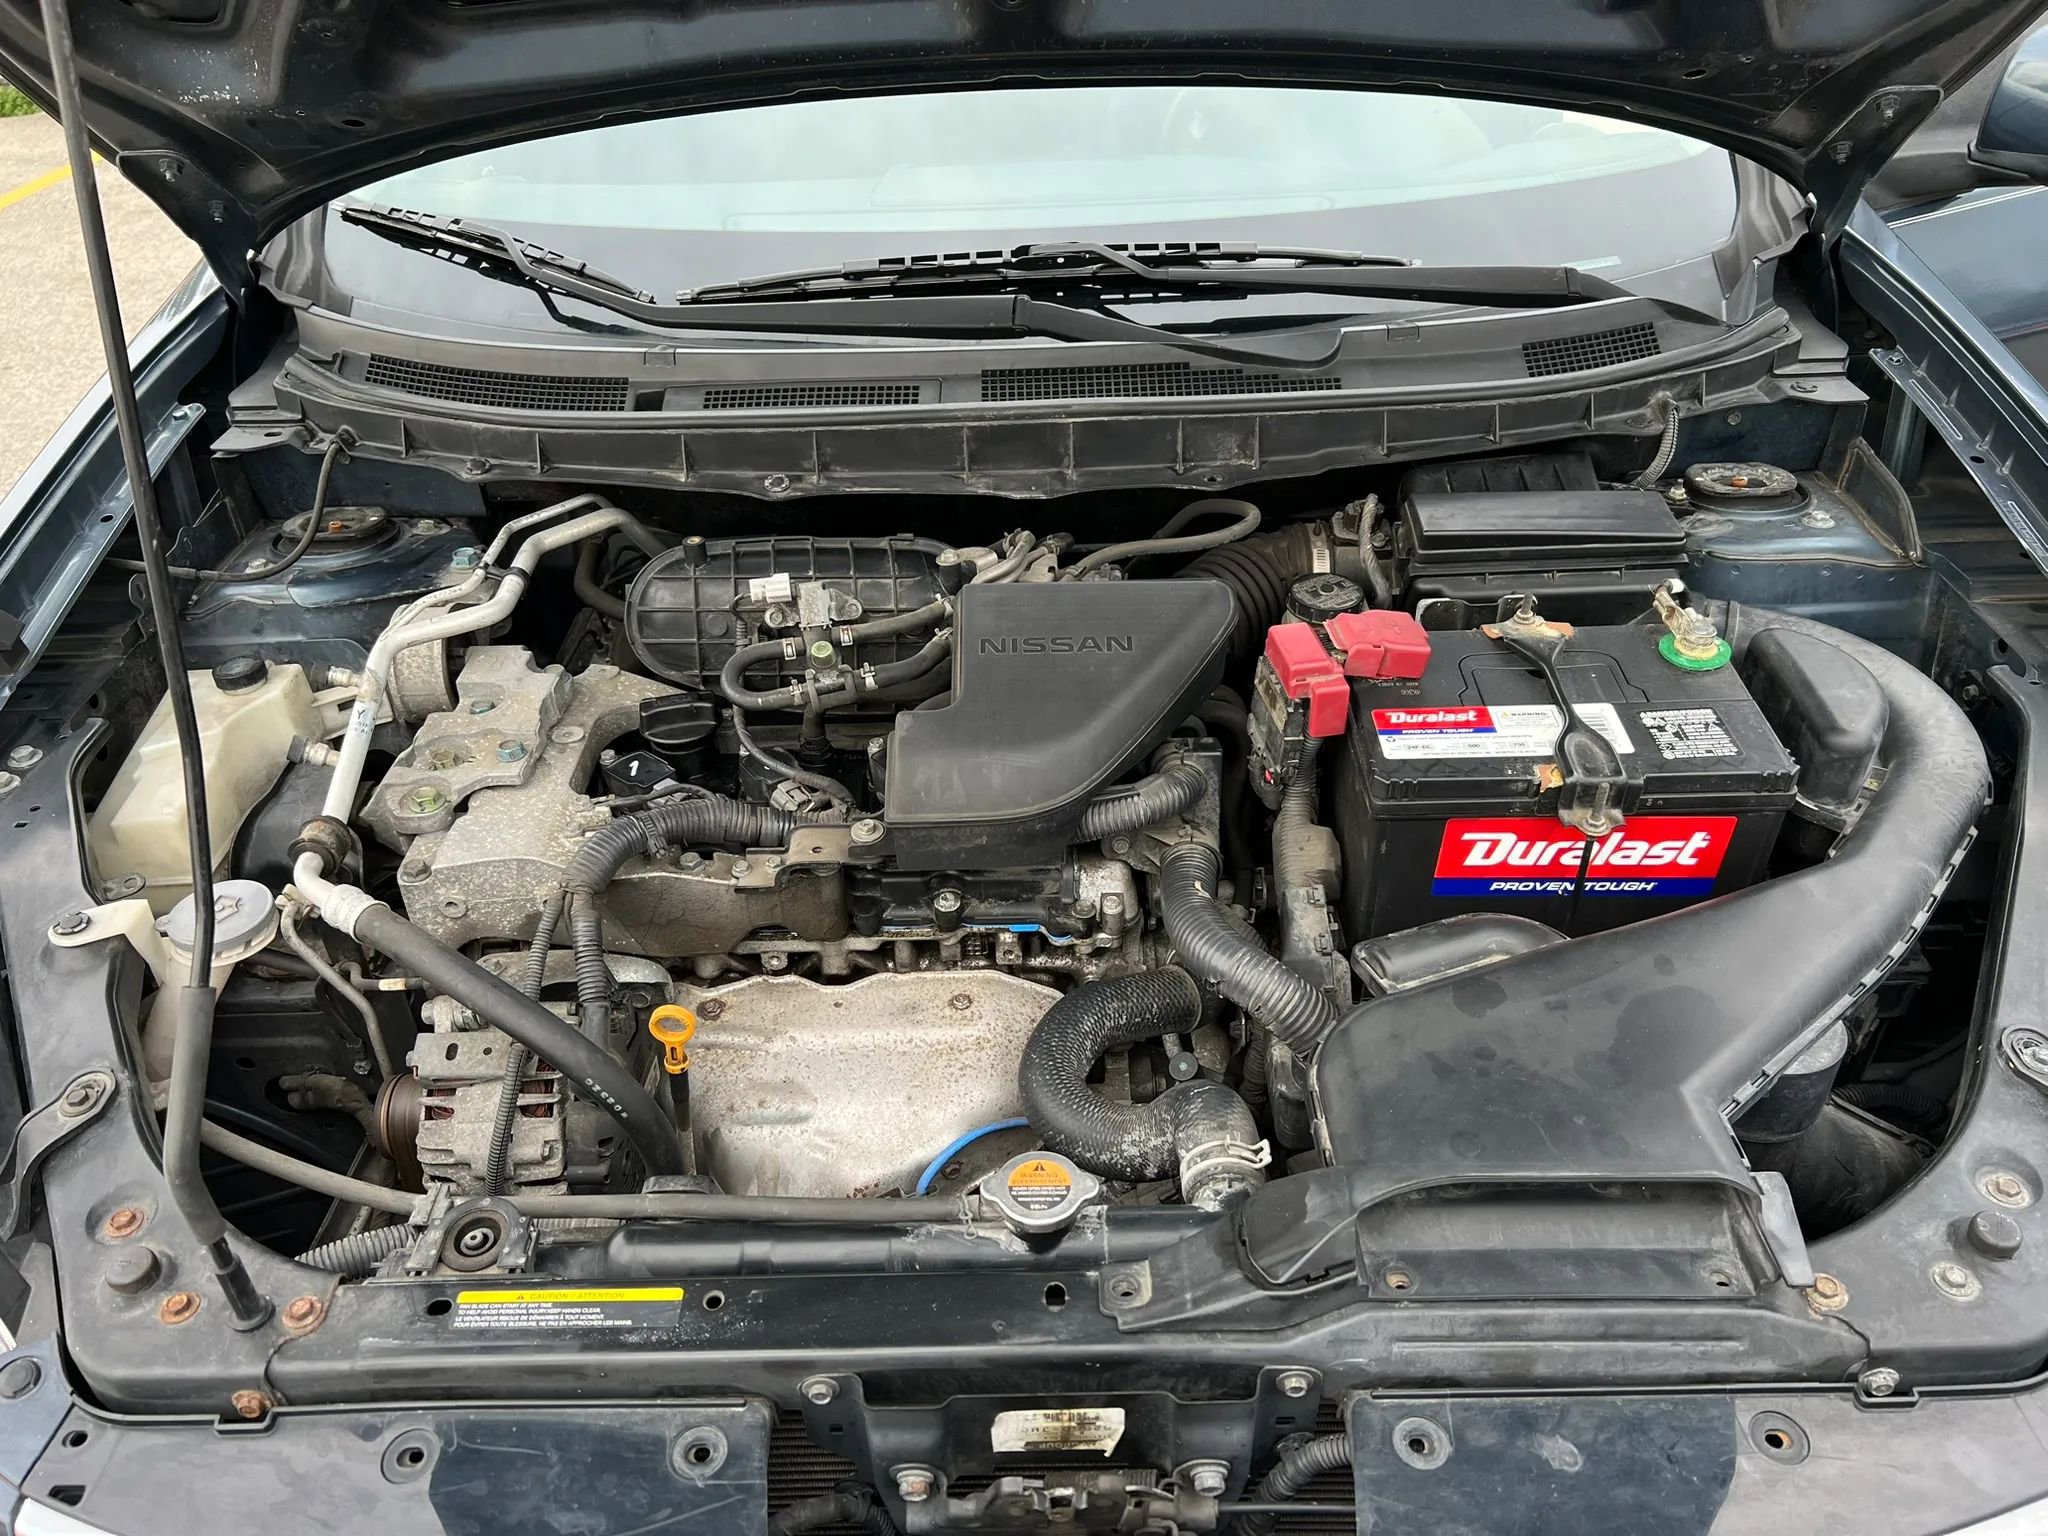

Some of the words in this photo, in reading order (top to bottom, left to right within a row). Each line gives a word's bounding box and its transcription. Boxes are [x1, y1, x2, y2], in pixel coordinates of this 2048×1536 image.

[978, 635, 1135, 656] NISSAN
[1385, 710, 1478, 724] Duralast
[629, 759, 639, 777] 1
[1460, 831, 1711, 866] Duralast
[1489, 881, 1576, 892] PROVEN
[1584, 881, 1655, 892] TOUGH
